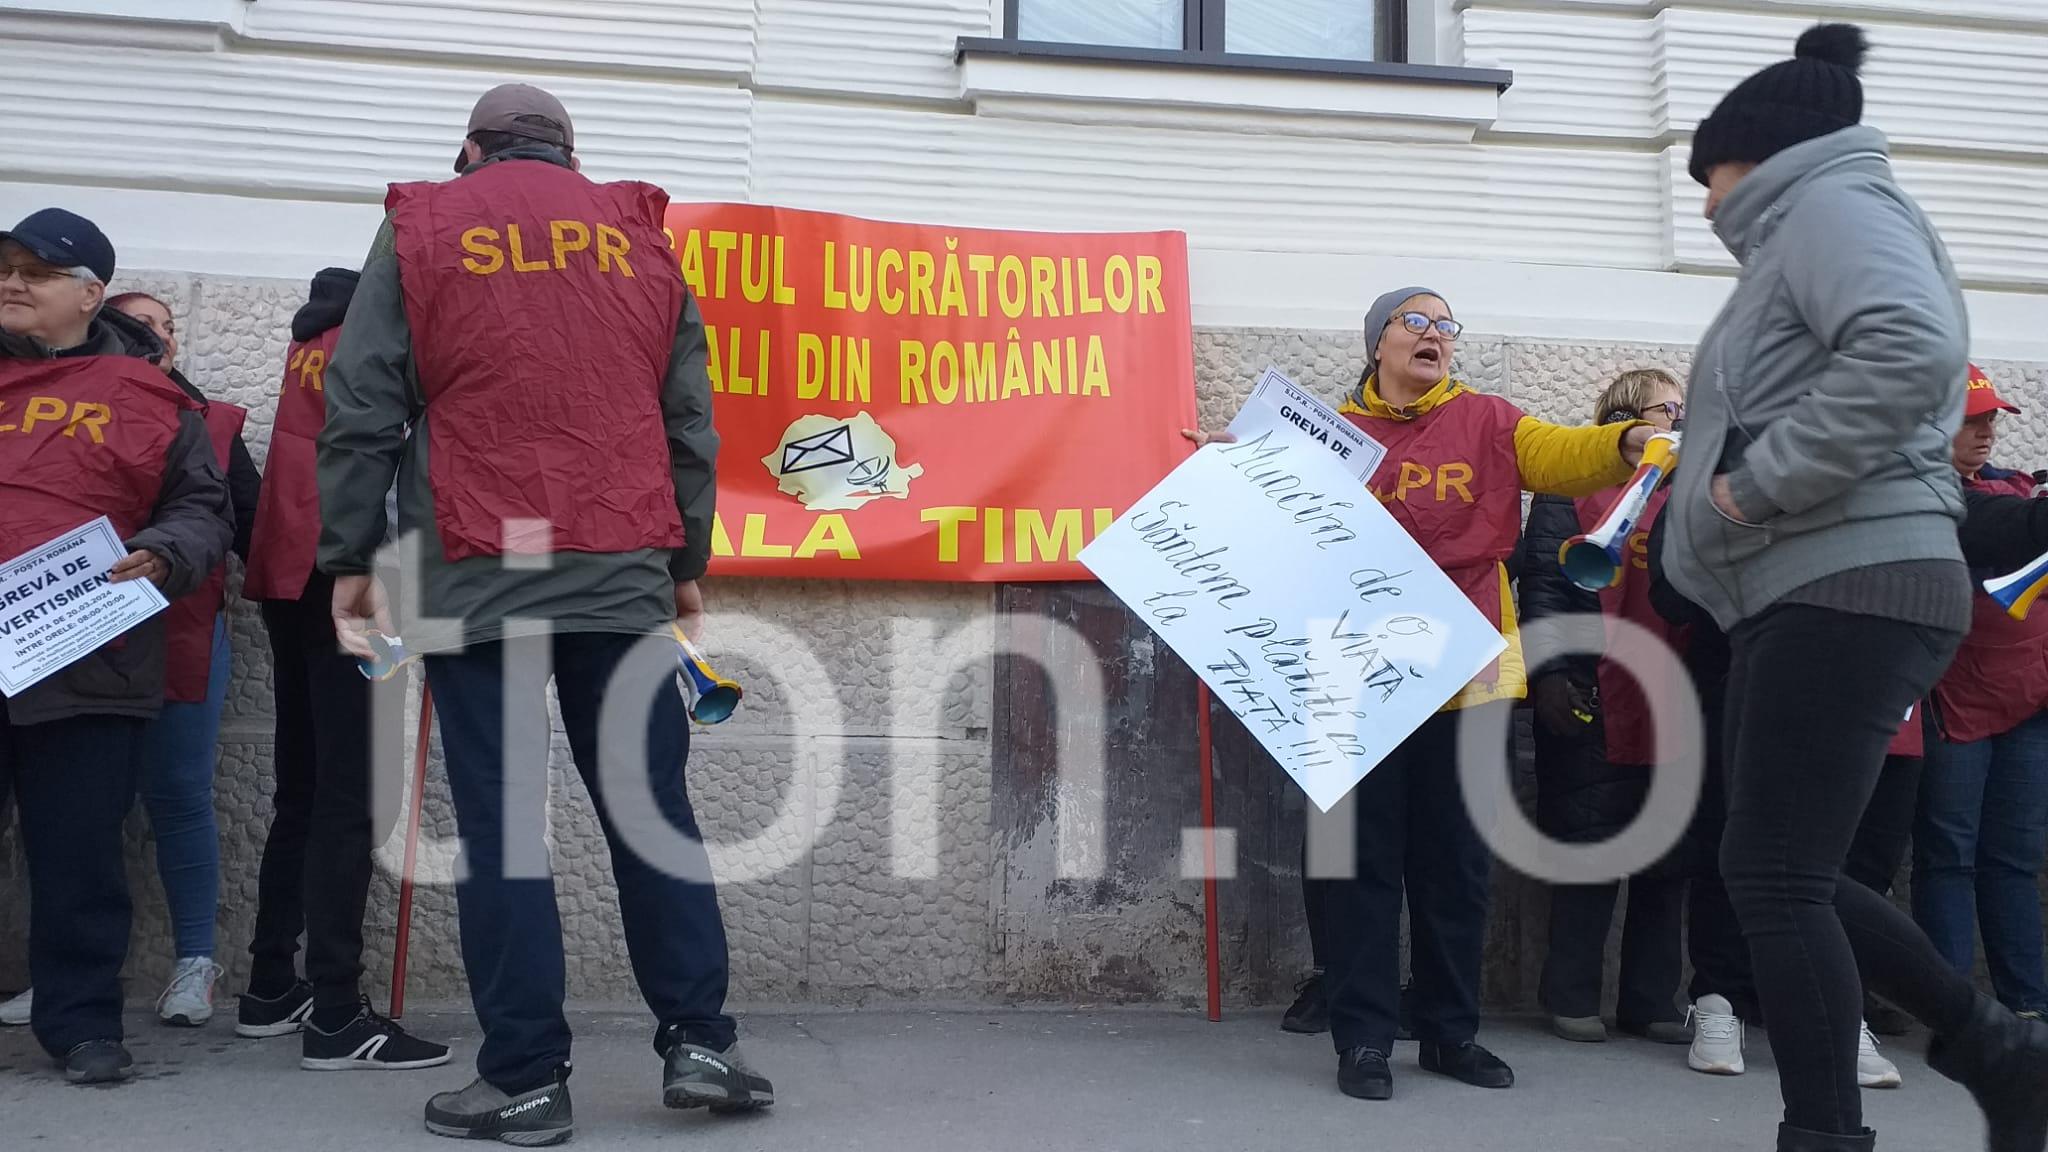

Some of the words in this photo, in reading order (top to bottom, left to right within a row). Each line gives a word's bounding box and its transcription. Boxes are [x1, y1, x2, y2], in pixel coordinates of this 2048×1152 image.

[461, 220, 635, 278] SLPR
[664, 227, 796, 305] ATUL
[823, 236, 1166, 319] LUCRĂTORILOR
[797, 332, 871, 404] DIN
[900, 327, 1111, 405] ROMÂNIA
[1280, 405, 1330, 445] GREVĂ
[1330, 440, 1353, 460] DE
[62, 556, 91, 577] DE
[1349, 569, 1412, 603] de
[690, 1051, 729, 1075] SCARPA
[500, 1095, 551, 1120] SCARPA
